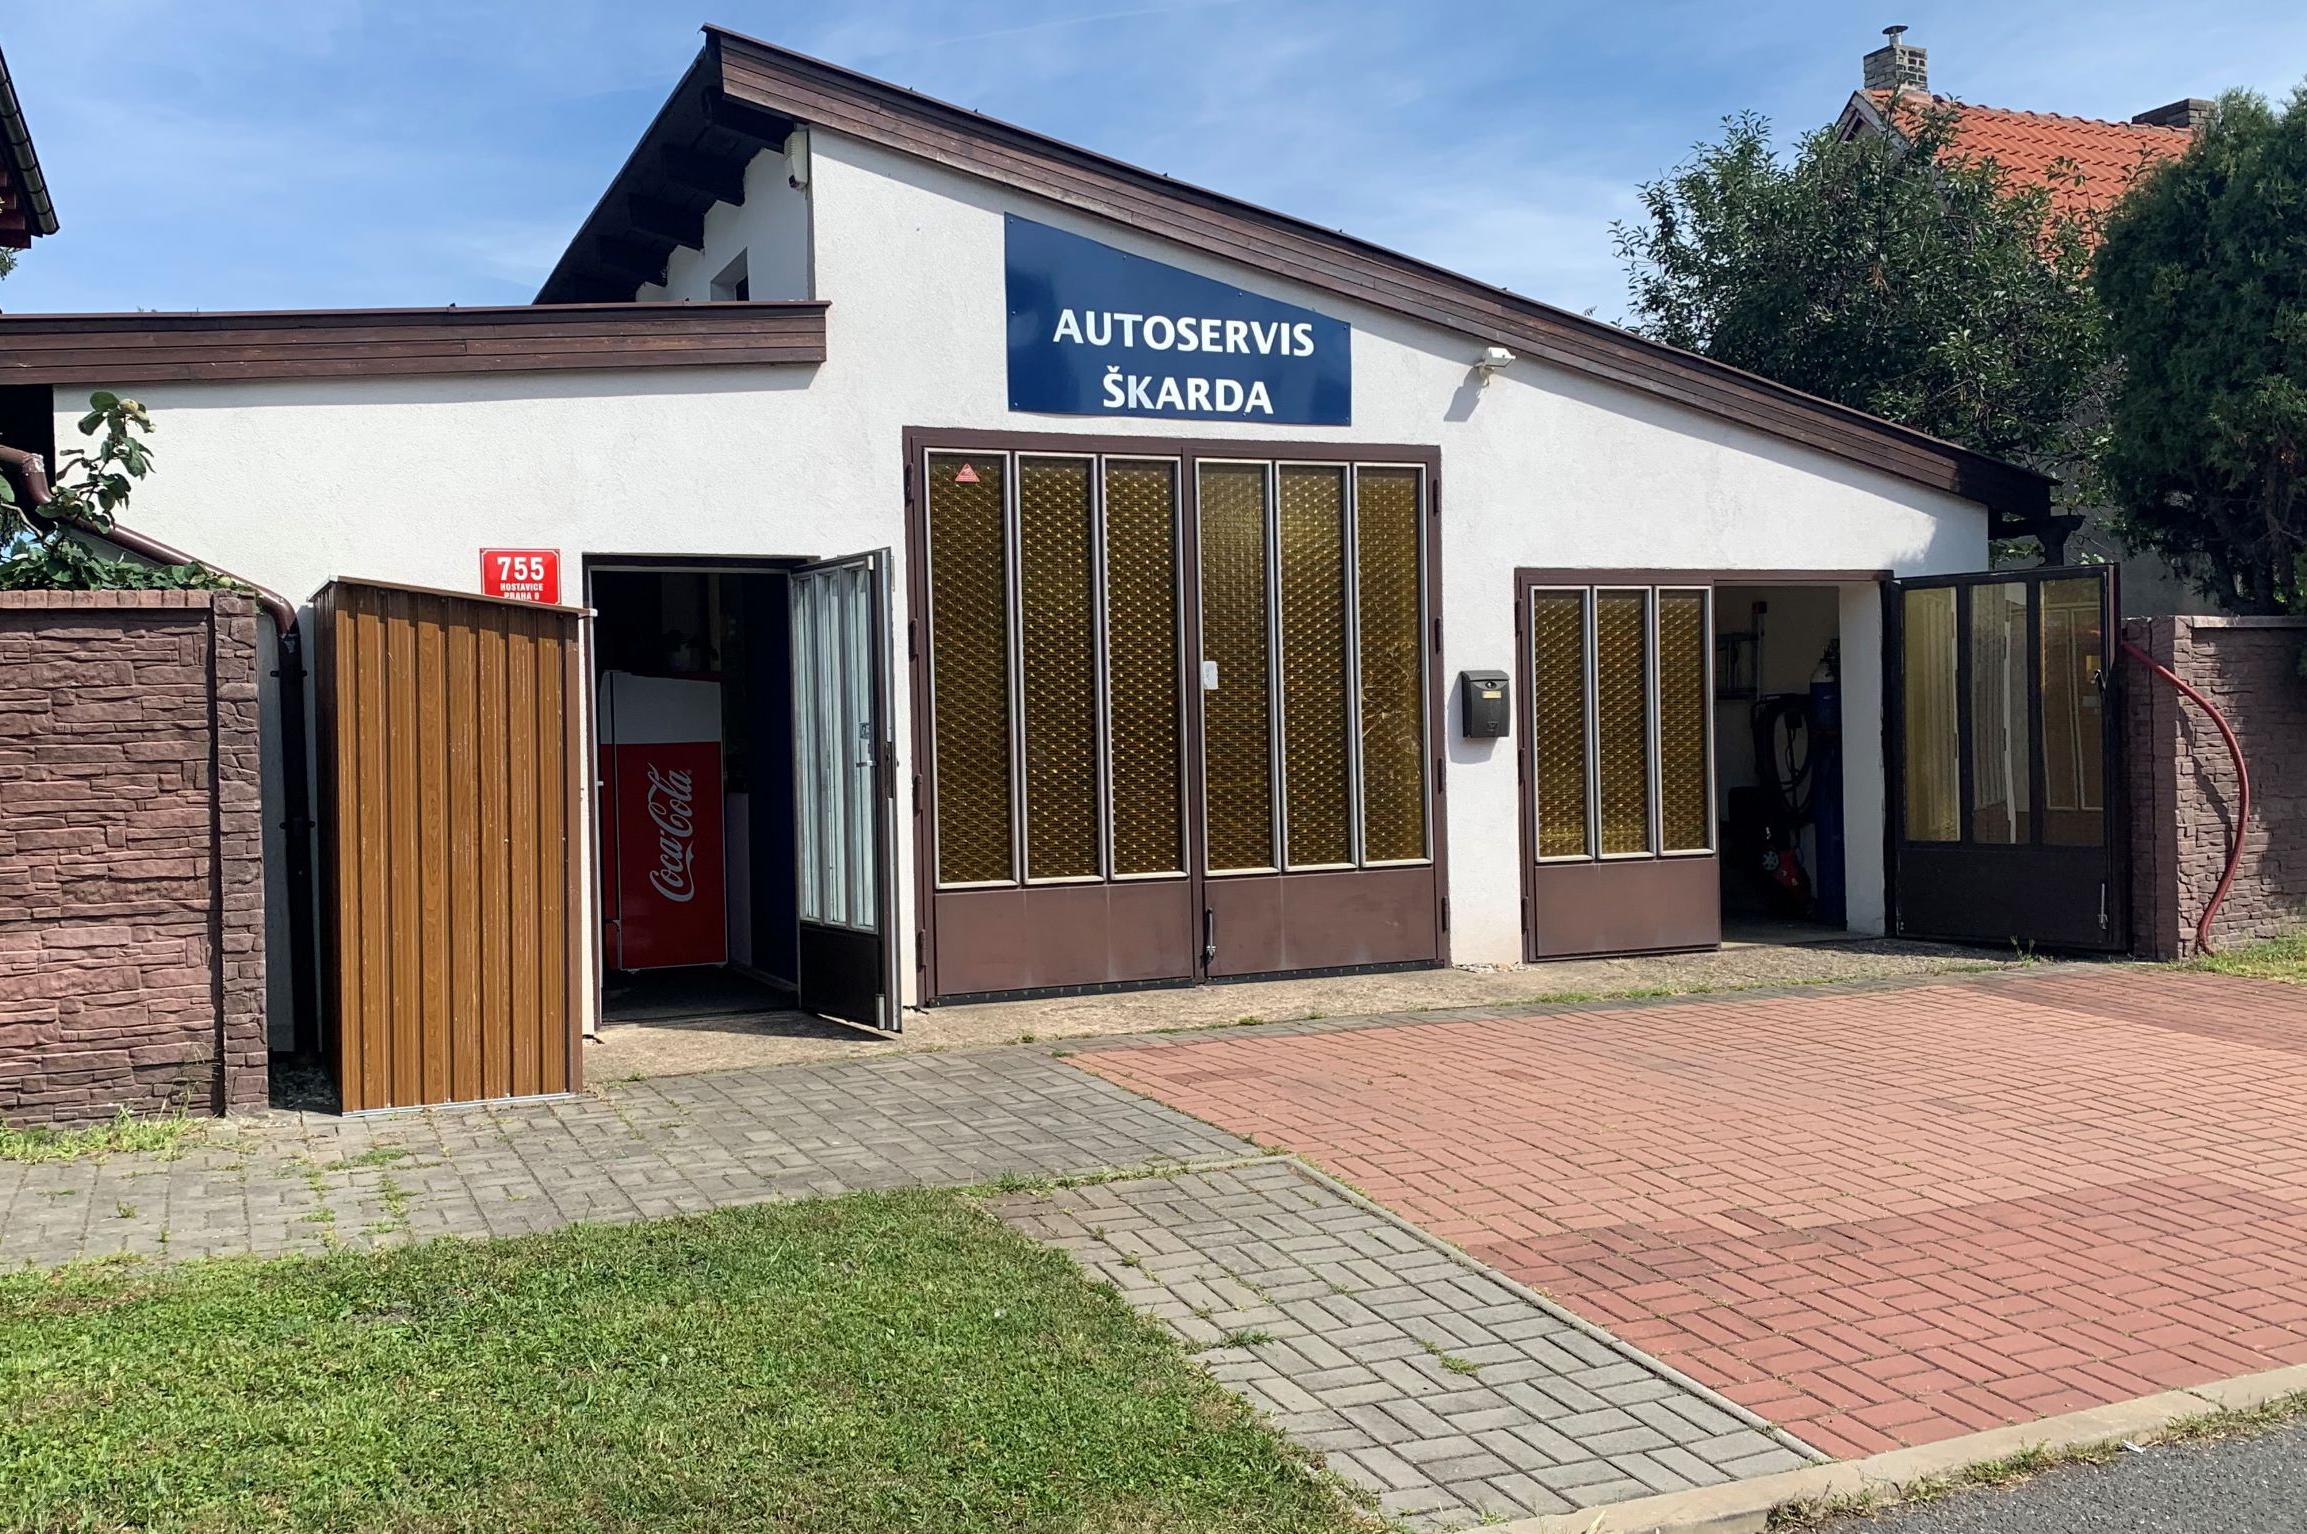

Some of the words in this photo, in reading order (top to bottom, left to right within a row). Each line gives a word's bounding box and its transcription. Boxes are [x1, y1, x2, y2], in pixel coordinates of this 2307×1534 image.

[1053, 308, 1315, 357] AUTOSERVIS
[1102, 366, 1274, 414] ŠKARDA
[497, 556, 545, 581] 755
[500, 583, 544, 592] HOSTAVICE
[648, 762, 695, 902] Coca-Cola
